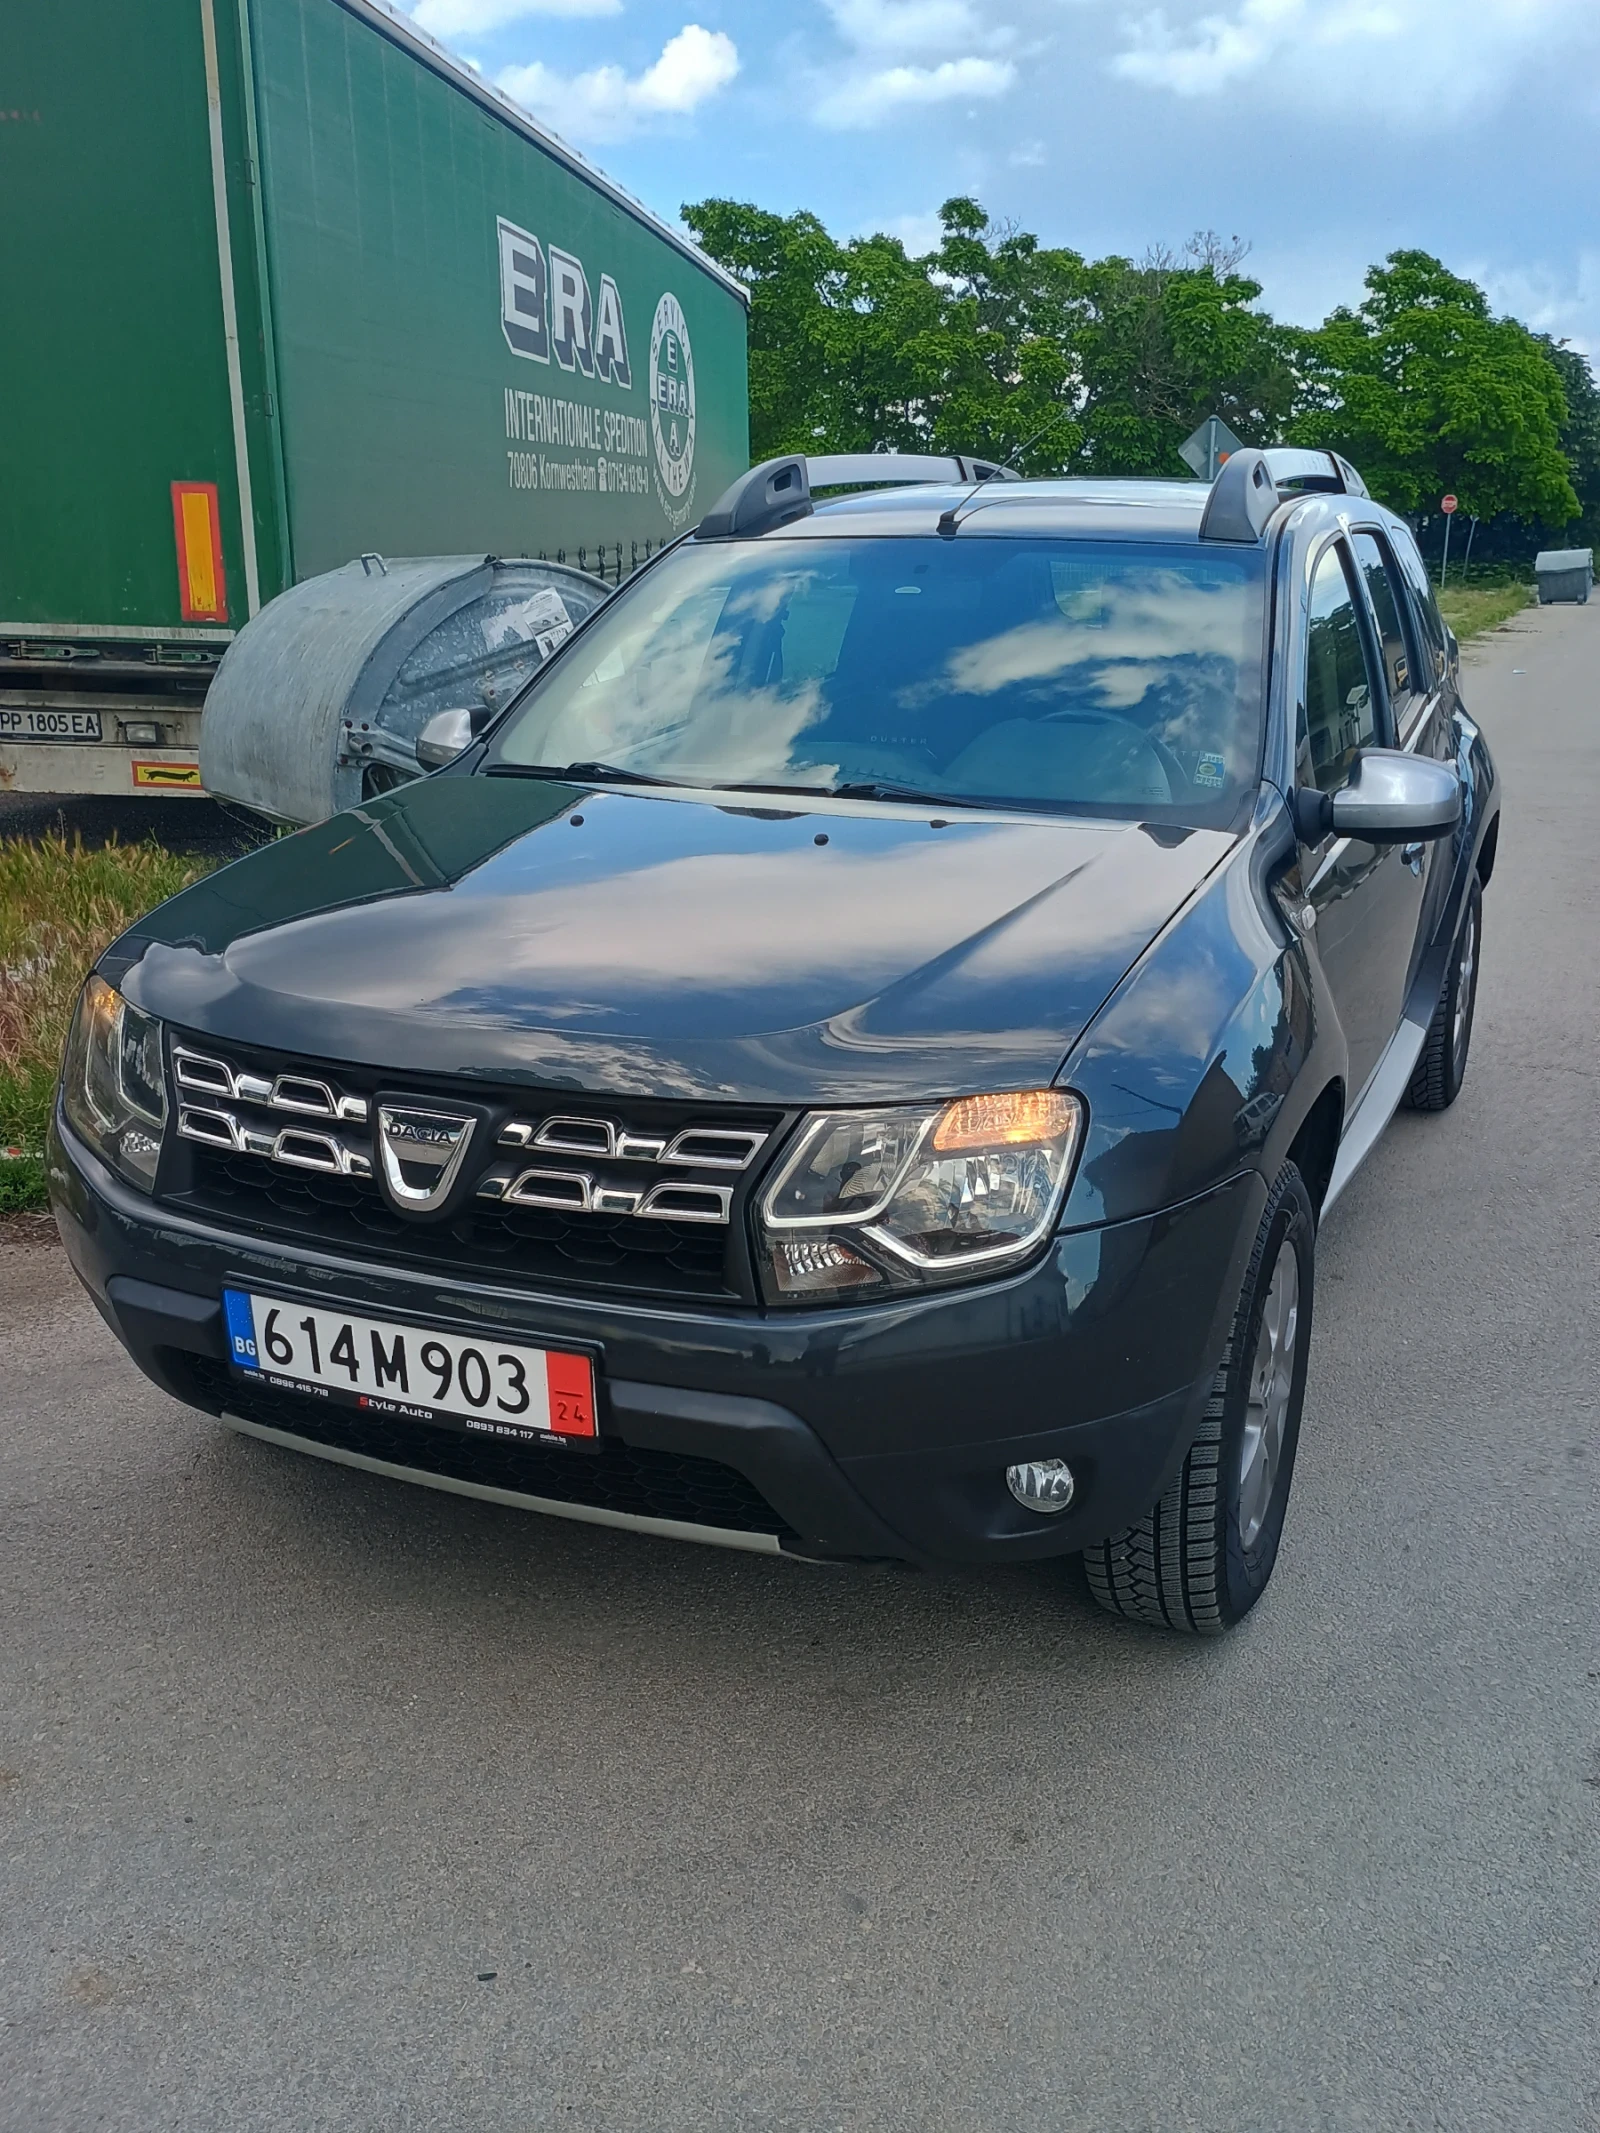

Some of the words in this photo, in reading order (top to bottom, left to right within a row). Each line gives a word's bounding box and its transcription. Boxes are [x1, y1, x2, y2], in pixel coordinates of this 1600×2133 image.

[497, 215, 632, 390] ERA
[652, 299, 691, 376] SERVICE
[504, 387, 601, 450] INTERNATIONALE
[603, 410, 648, 457] SPEDITION
[657, 371, 690, 418] ERA
[507, 451, 538, 489] 70806
[539, 453, 597, 491] Kornwestheim
[667, 459, 683, 492] THE
[27, 713, 69, 733] 1805
[71, 715, 97, 734] EA
[388, 1122, 454, 1144] DACIA
[234, 1335, 257, 1356] BG
[556, 1400, 586, 1423] 24
[269, 1376, 295, 1389] 0896
[296, 1383, 312, 1393] 415
[359, 1396, 397, 1413] Style
[399, 1403, 433, 1420] Auto
[466, 1420, 495, 1432] 0893
[496, 1424, 518, 1437] 834
[519, 1429, 534, 1440] 117
